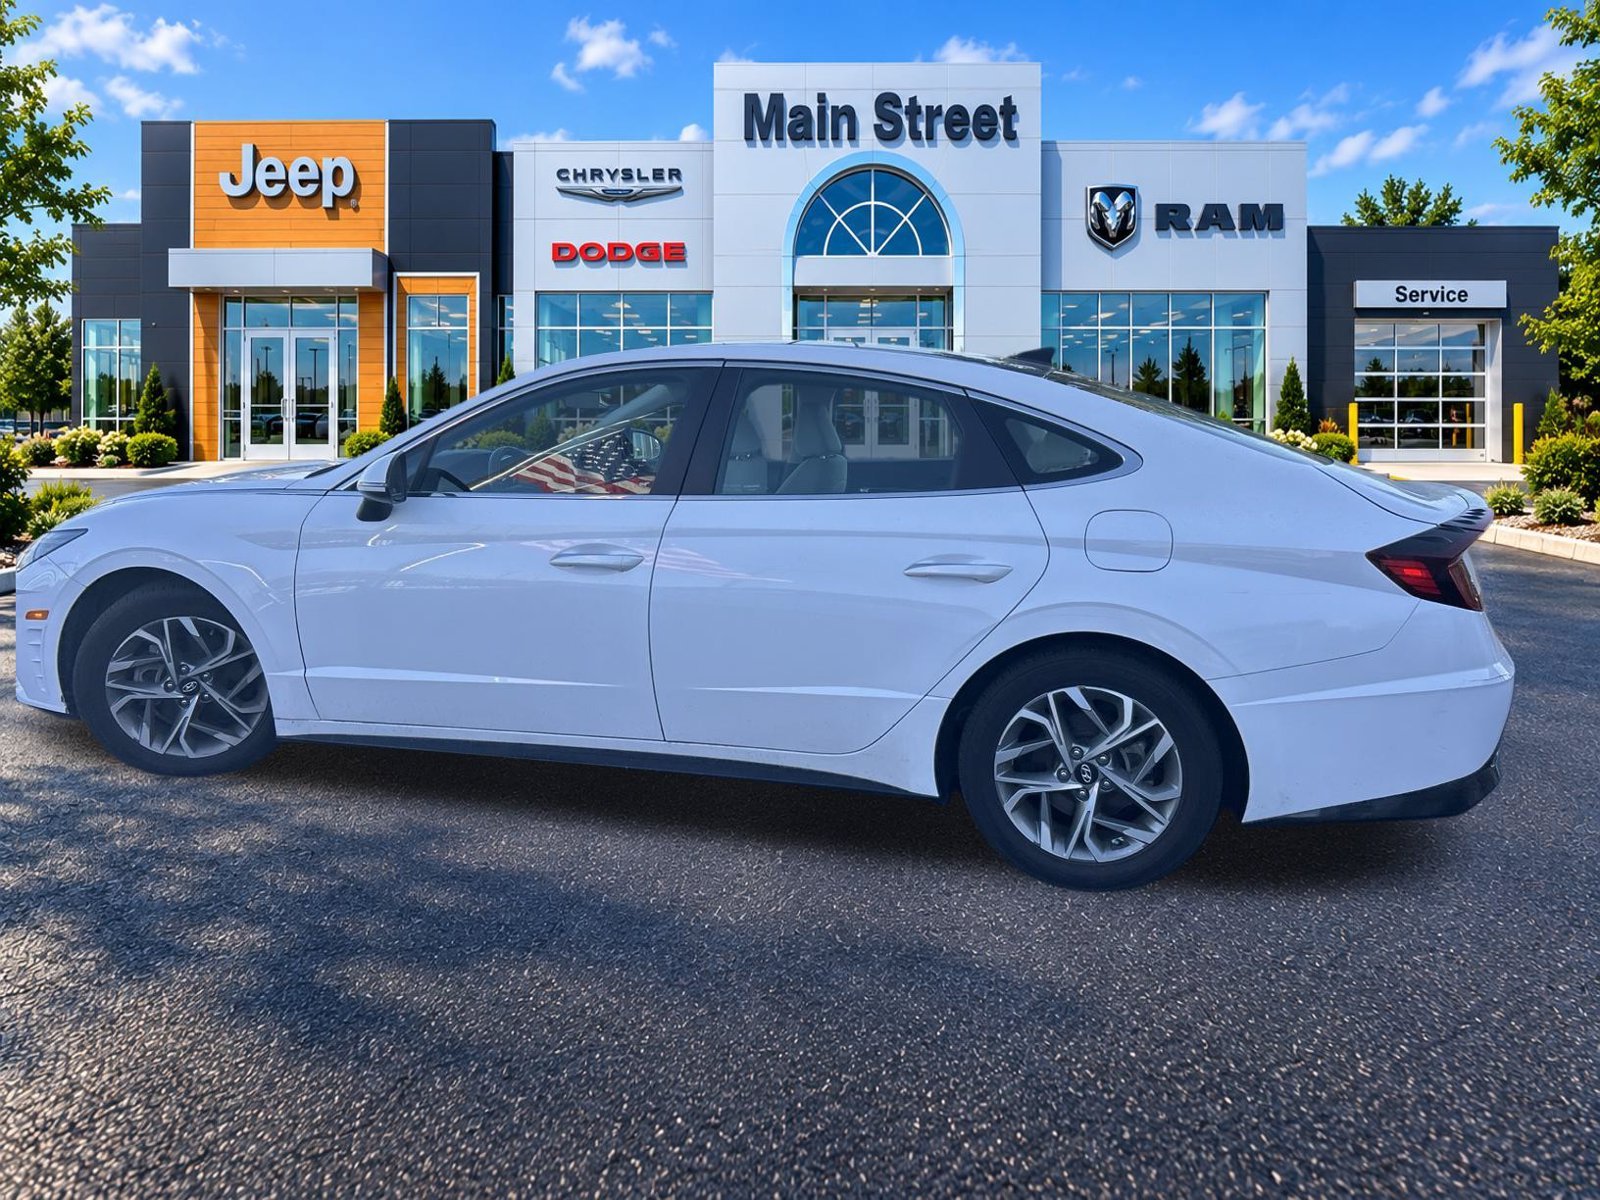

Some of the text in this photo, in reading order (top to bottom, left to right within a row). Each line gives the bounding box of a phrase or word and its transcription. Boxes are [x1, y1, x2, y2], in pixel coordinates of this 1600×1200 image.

[743, 91, 1018, 141] Main Street
[218, 143, 355, 208] Jeep
[556, 168, 682, 181] CHRYSLER
[1155, 203, 1284, 231] RAM
[551, 242, 686, 262] DODGE
[1395, 285, 1469, 303] Service
